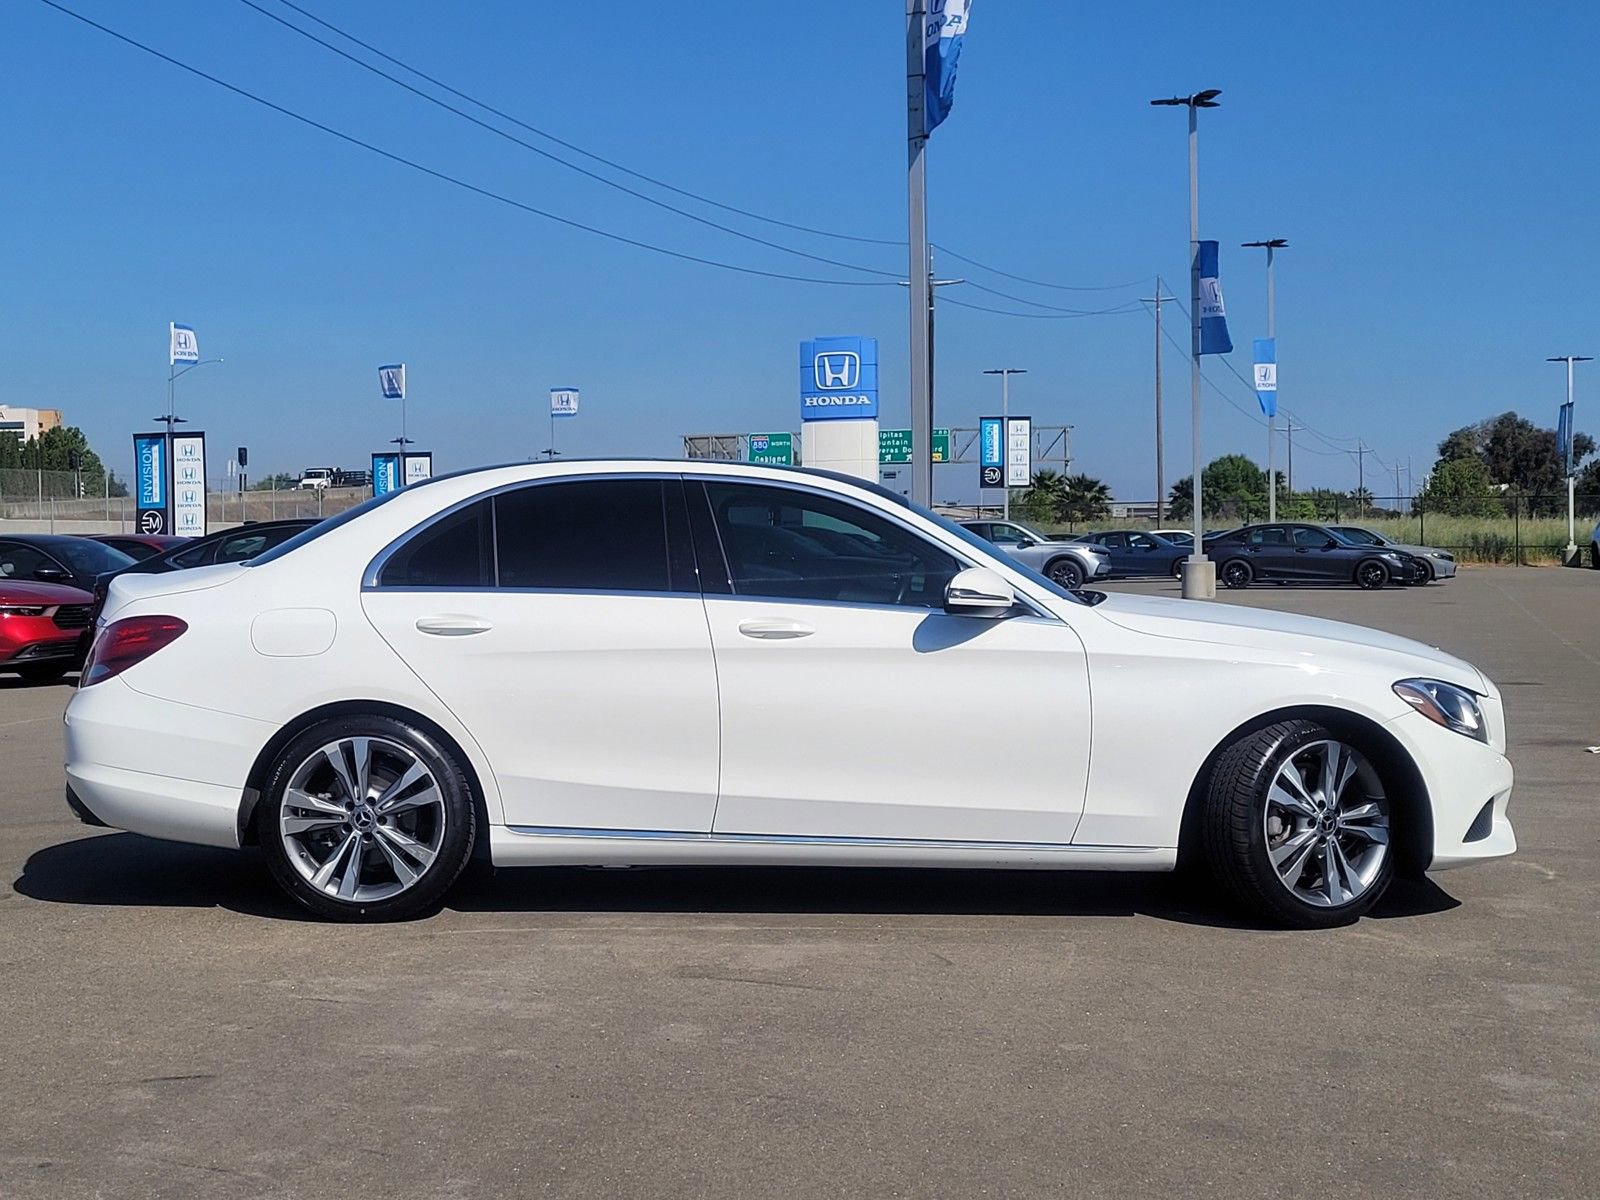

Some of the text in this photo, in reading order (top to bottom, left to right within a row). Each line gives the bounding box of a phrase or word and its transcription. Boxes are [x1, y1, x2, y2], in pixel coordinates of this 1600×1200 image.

[927, 14, 962, 37] ONDA
[804, 395, 872, 407] HONDA
[753, 441, 768, 449] 880
[985, 423, 993, 463] ENVISION
[142, 444, 153, 504] ENVISION
